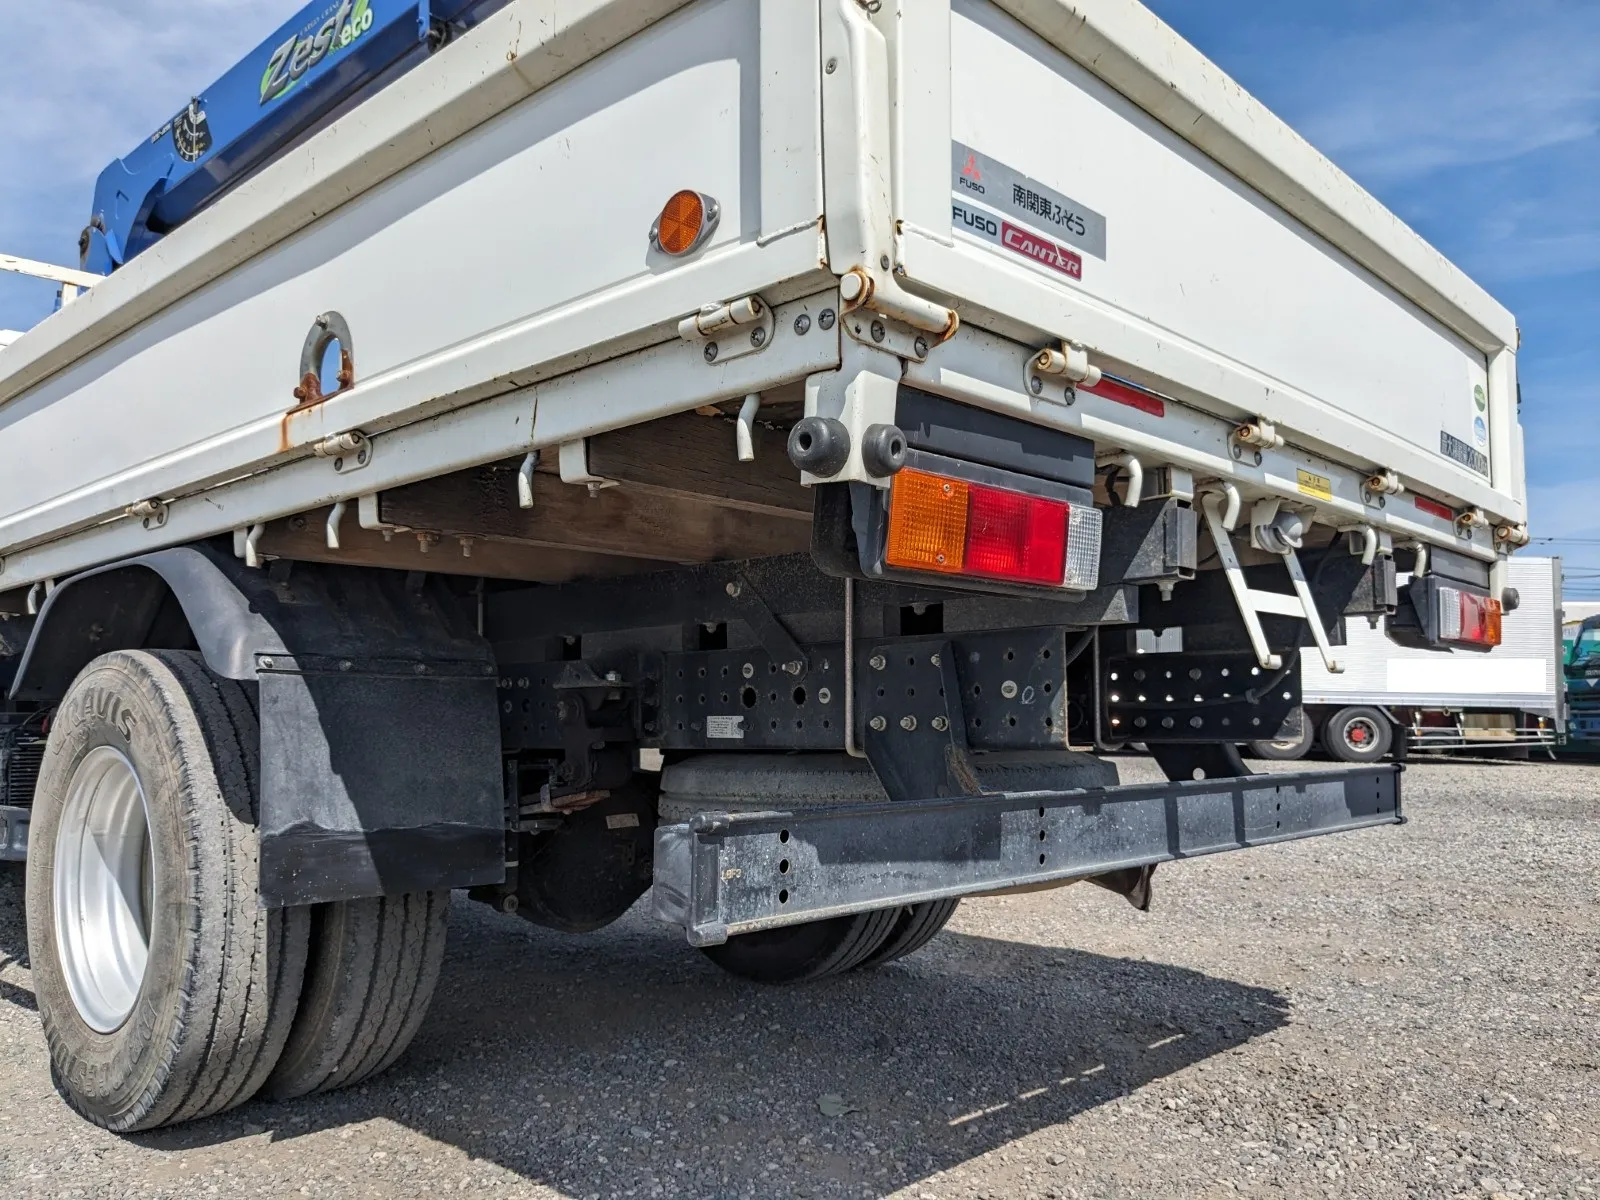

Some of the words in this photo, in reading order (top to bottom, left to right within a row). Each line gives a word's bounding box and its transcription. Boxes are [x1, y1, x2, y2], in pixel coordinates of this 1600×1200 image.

[260, 0, 353, 105] Zest
[340, 8, 373, 46] eco
[959, 177, 985, 194] FUSO
[1012, 183, 1086, 236] 南関東ふそう
[952, 206, 998, 236] FUSO
[1004, 228, 1079, 274] CANTER
